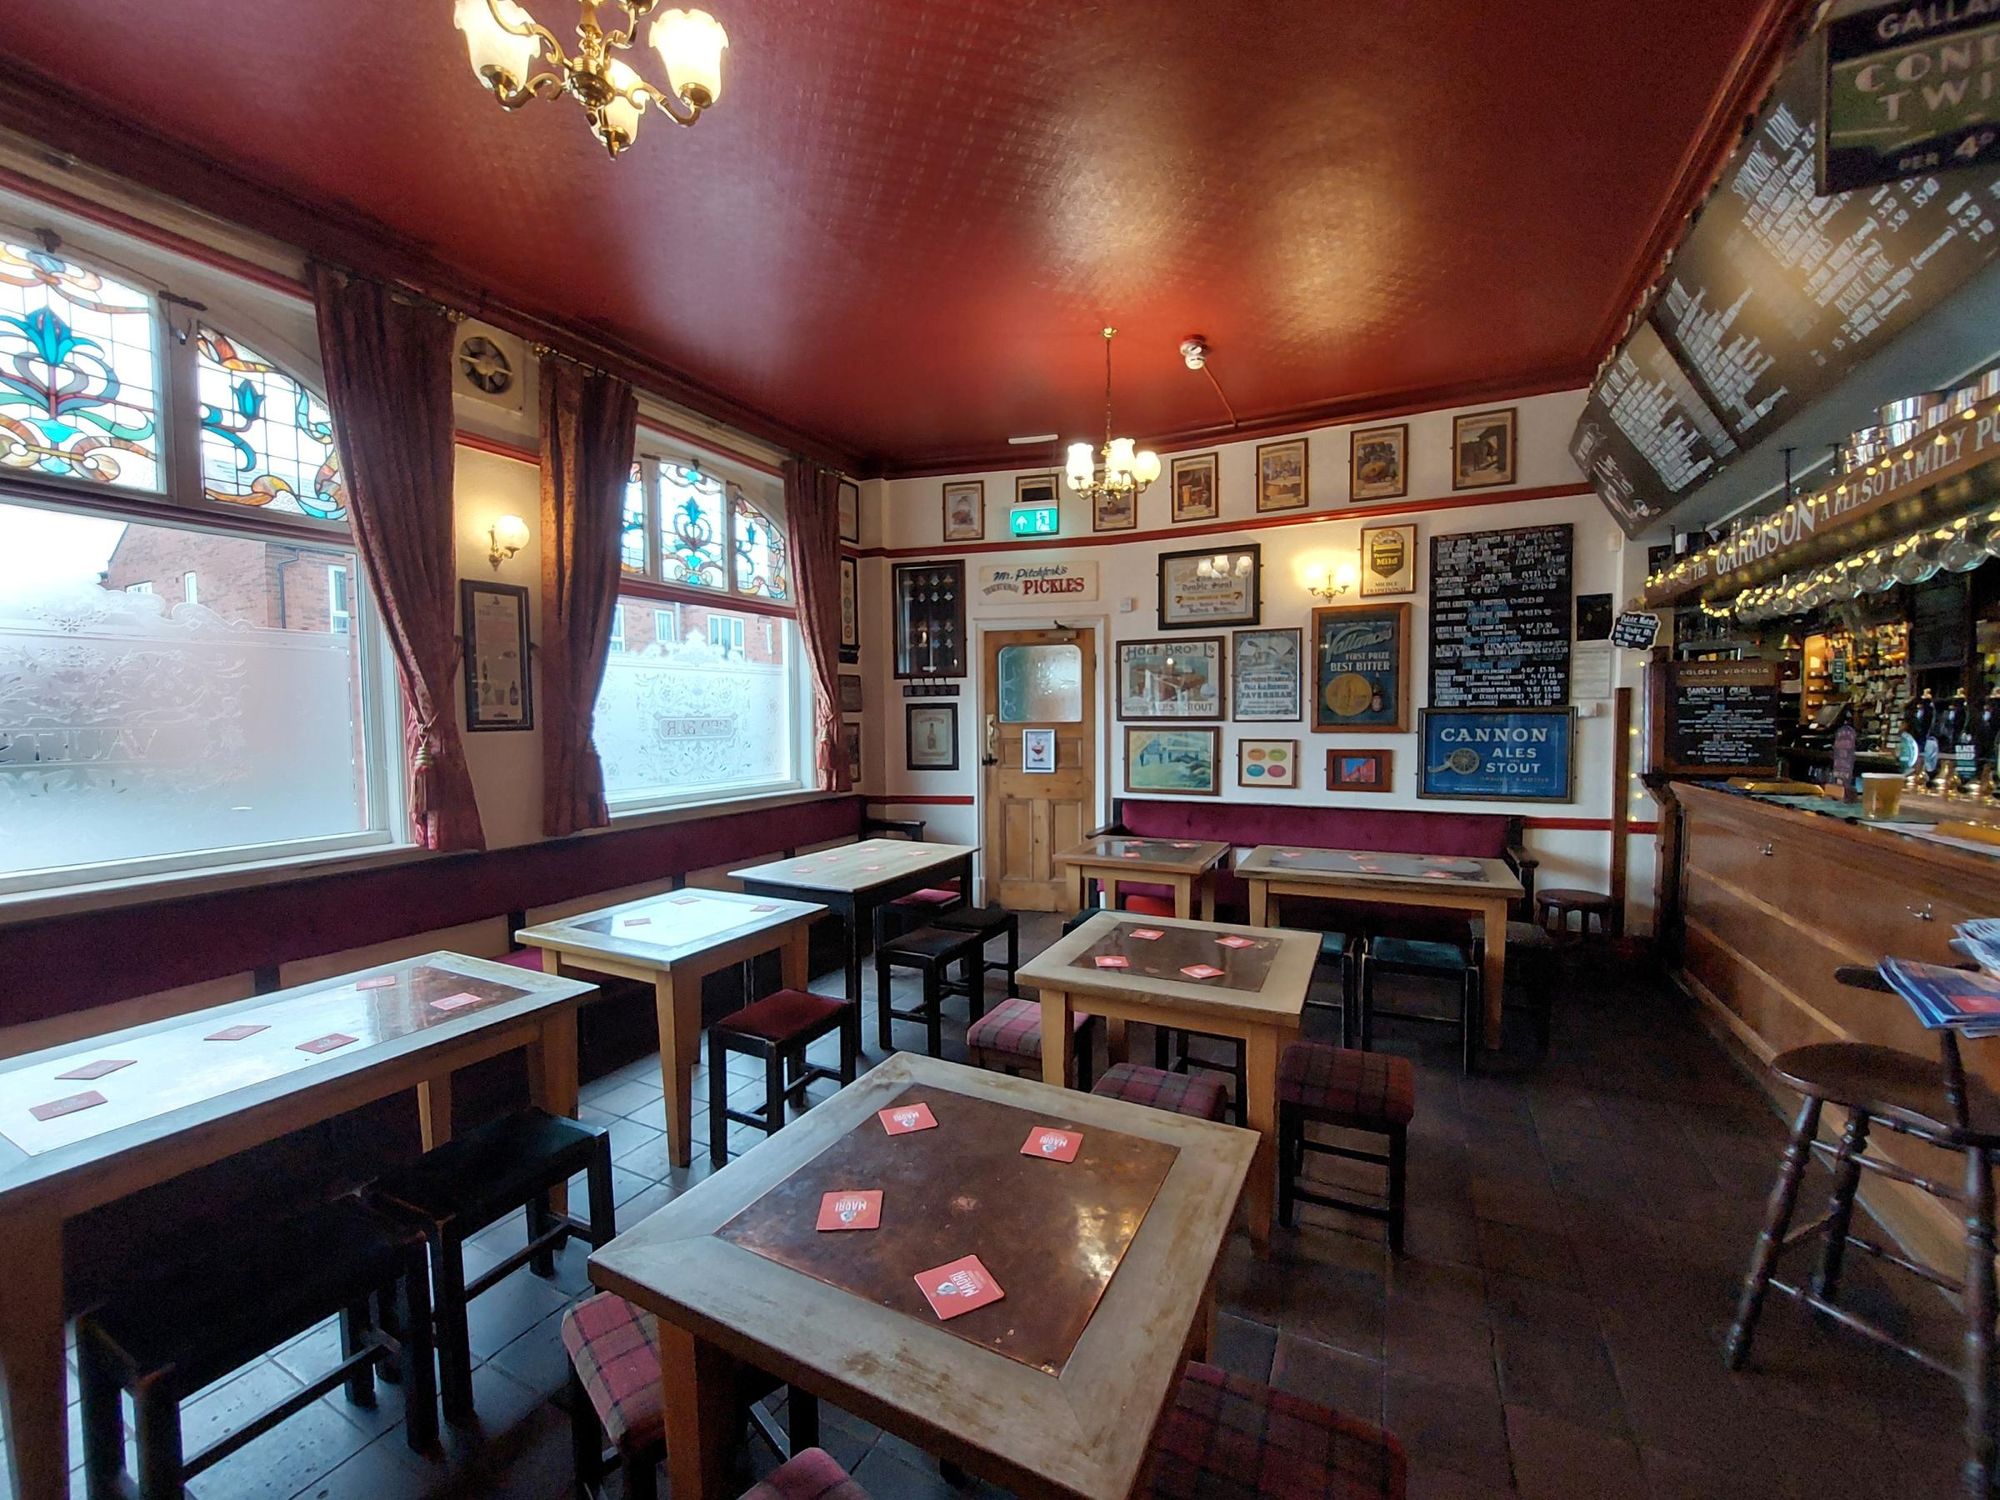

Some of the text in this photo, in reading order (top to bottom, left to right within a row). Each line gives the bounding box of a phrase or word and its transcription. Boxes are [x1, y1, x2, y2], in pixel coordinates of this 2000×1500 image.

[1876, 72, 1993, 121] TWI
[1765, 103, 1802, 151] WINE
[1716, 498, 1816, 575] GARRISON
[1889, 427, 1967, 490] FAMILY
[1022, 577, 1085, 595] PICKLES
[1123, 645, 1159, 662] HOLT
[1345, 651, 1390, 660] FIRST PRIZE
[1330, 661, 1390, 672] BEST BITTER
[1440, 728, 1548, 742] CANNON
[1491, 747, 1537, 758] ALES
[1485, 762, 1541, 774] STOUT
